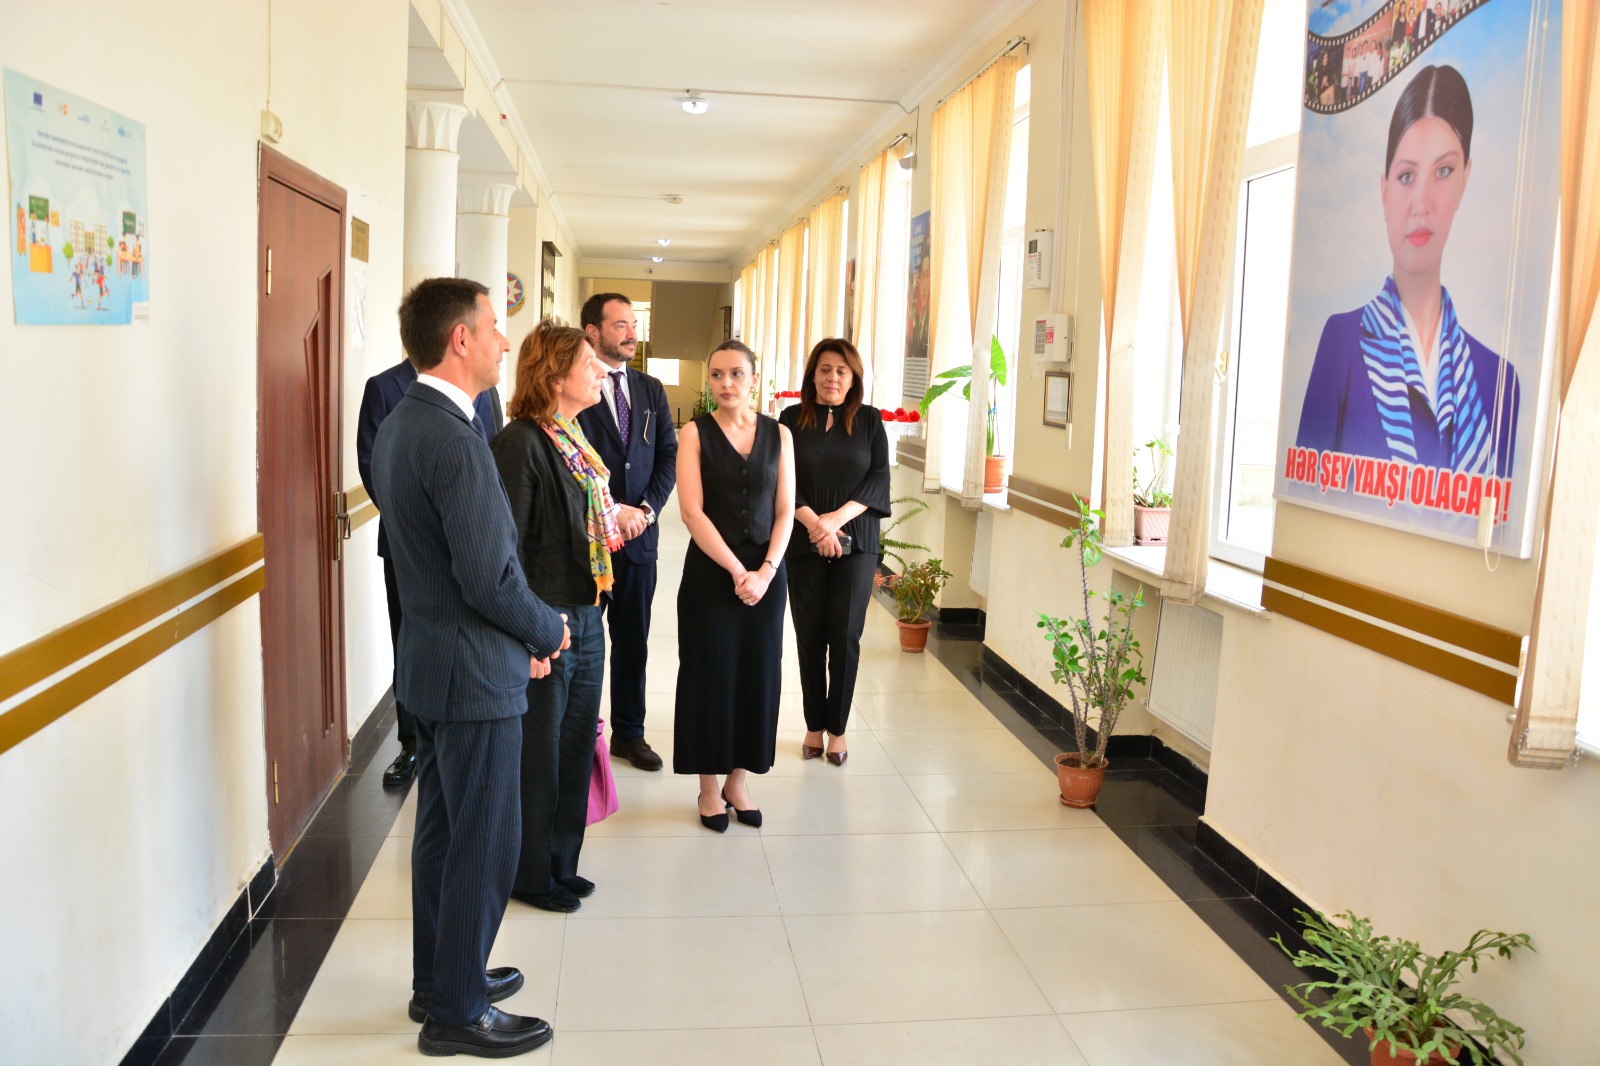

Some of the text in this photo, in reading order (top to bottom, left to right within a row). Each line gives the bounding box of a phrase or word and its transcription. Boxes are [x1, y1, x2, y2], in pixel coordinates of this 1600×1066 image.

[1285, 447, 1317, 484] HƏR
[1320, 452, 1351, 492] ŞEY
[1354, 458, 1407, 507] YAXŞI
